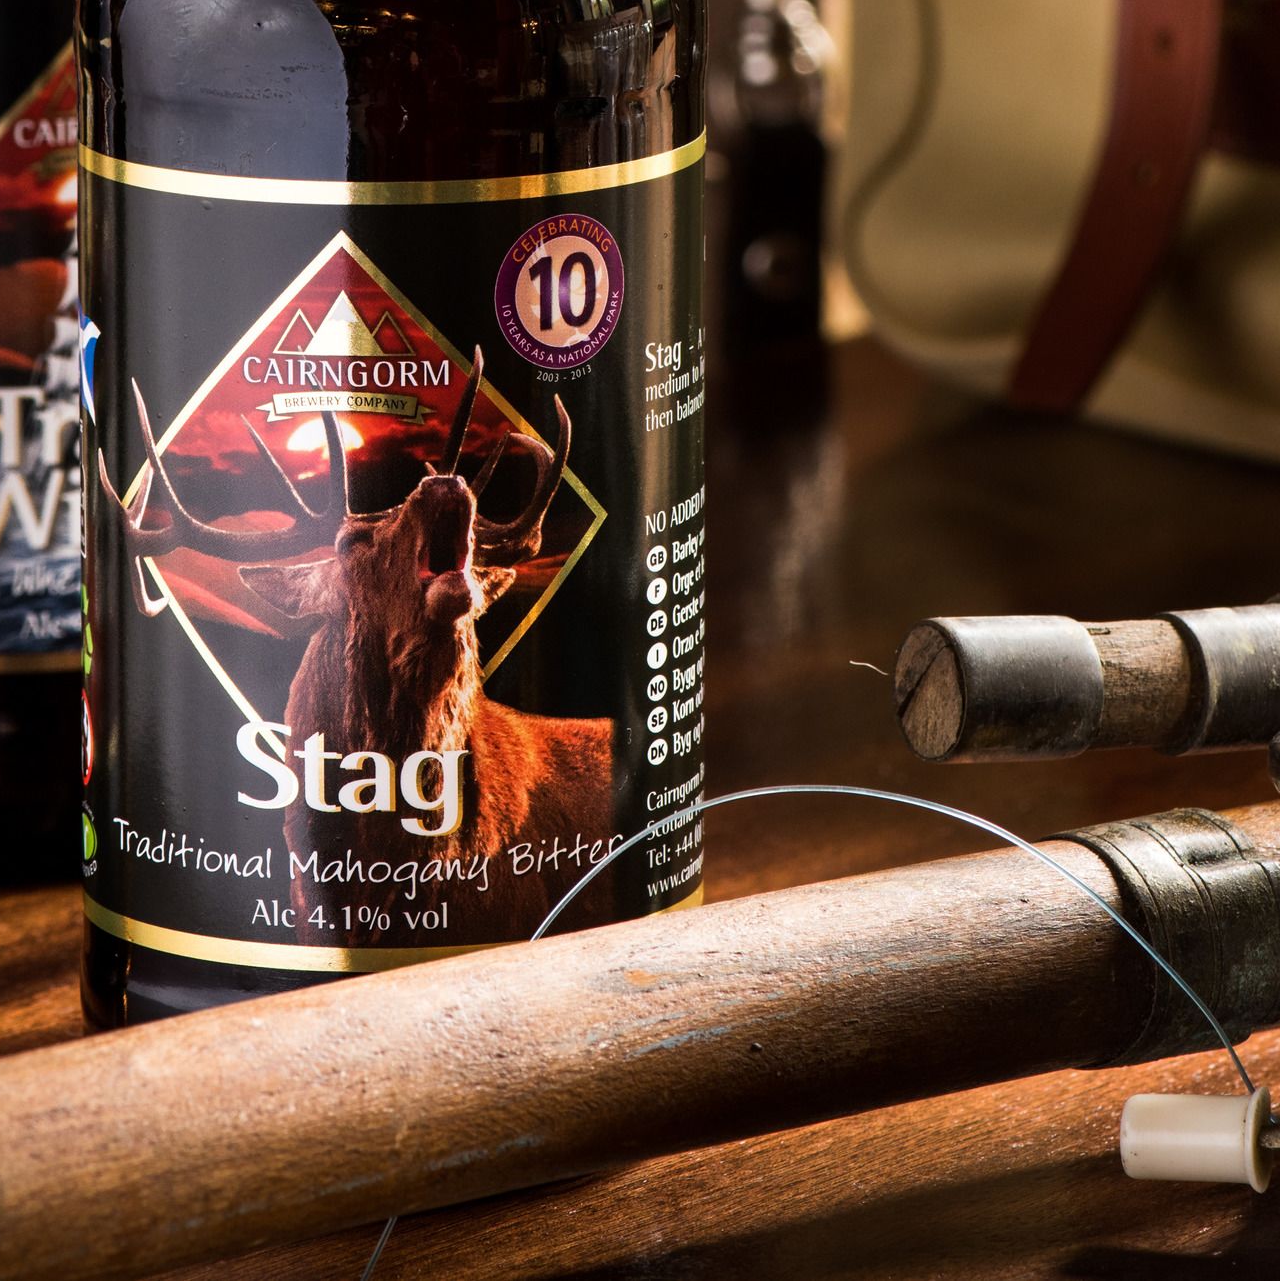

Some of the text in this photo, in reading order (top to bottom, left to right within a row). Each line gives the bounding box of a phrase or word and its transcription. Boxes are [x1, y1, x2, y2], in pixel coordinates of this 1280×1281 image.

[512, 219, 612, 263] CELEBRATING
[528, 251, 596, 331] 10
[505, 319, 532, 352] YEARS
[531, 348, 546, 362] AS
[546, 355, 554, 364] A
[558, 327, 609, 365] NATIONAL
[606, 290, 620, 323] PARK
[243, 356, 450, 388] CAIRNGORM
[536, 370, 559, 383] 2003
[570, 364, 592, 380] 2013
[645, 341, 682, 372] Stag
[644, 371, 689, 402] medium
[692, 365, 699, 384] to
[284, 395, 408, 410] BREWERY COMPANY
[645, 408, 673, 432] then
[645, 510, 667, 536] NO
[670, 492, 700, 528] ADDED
[649, 550, 665, 567] GB
[672, 533, 699, 563] Barley
[672, 569, 694, 595] Orge
[650, 615, 664, 632] DE
[672, 596, 699, 626] Gerste
[672, 634, 694, 658] Orzo
[650, 680, 665, 696] NO
[672, 664, 696, 694] Bygg
[651, 712, 664, 728] SE
[672, 697, 694, 723] Korn
[650, 743, 665, 760] DK
[672, 730, 692, 757] Byg
[235, 719, 469, 838] Stag
[646, 772, 700, 812] Cairngorm
[113, 817, 624, 900] Traditional Mahogany Bitter
[646, 843, 671, 869] Tel:
[674, 831, 693, 858] +44
[251, 898, 448, 932] Alc 4.1% vol
